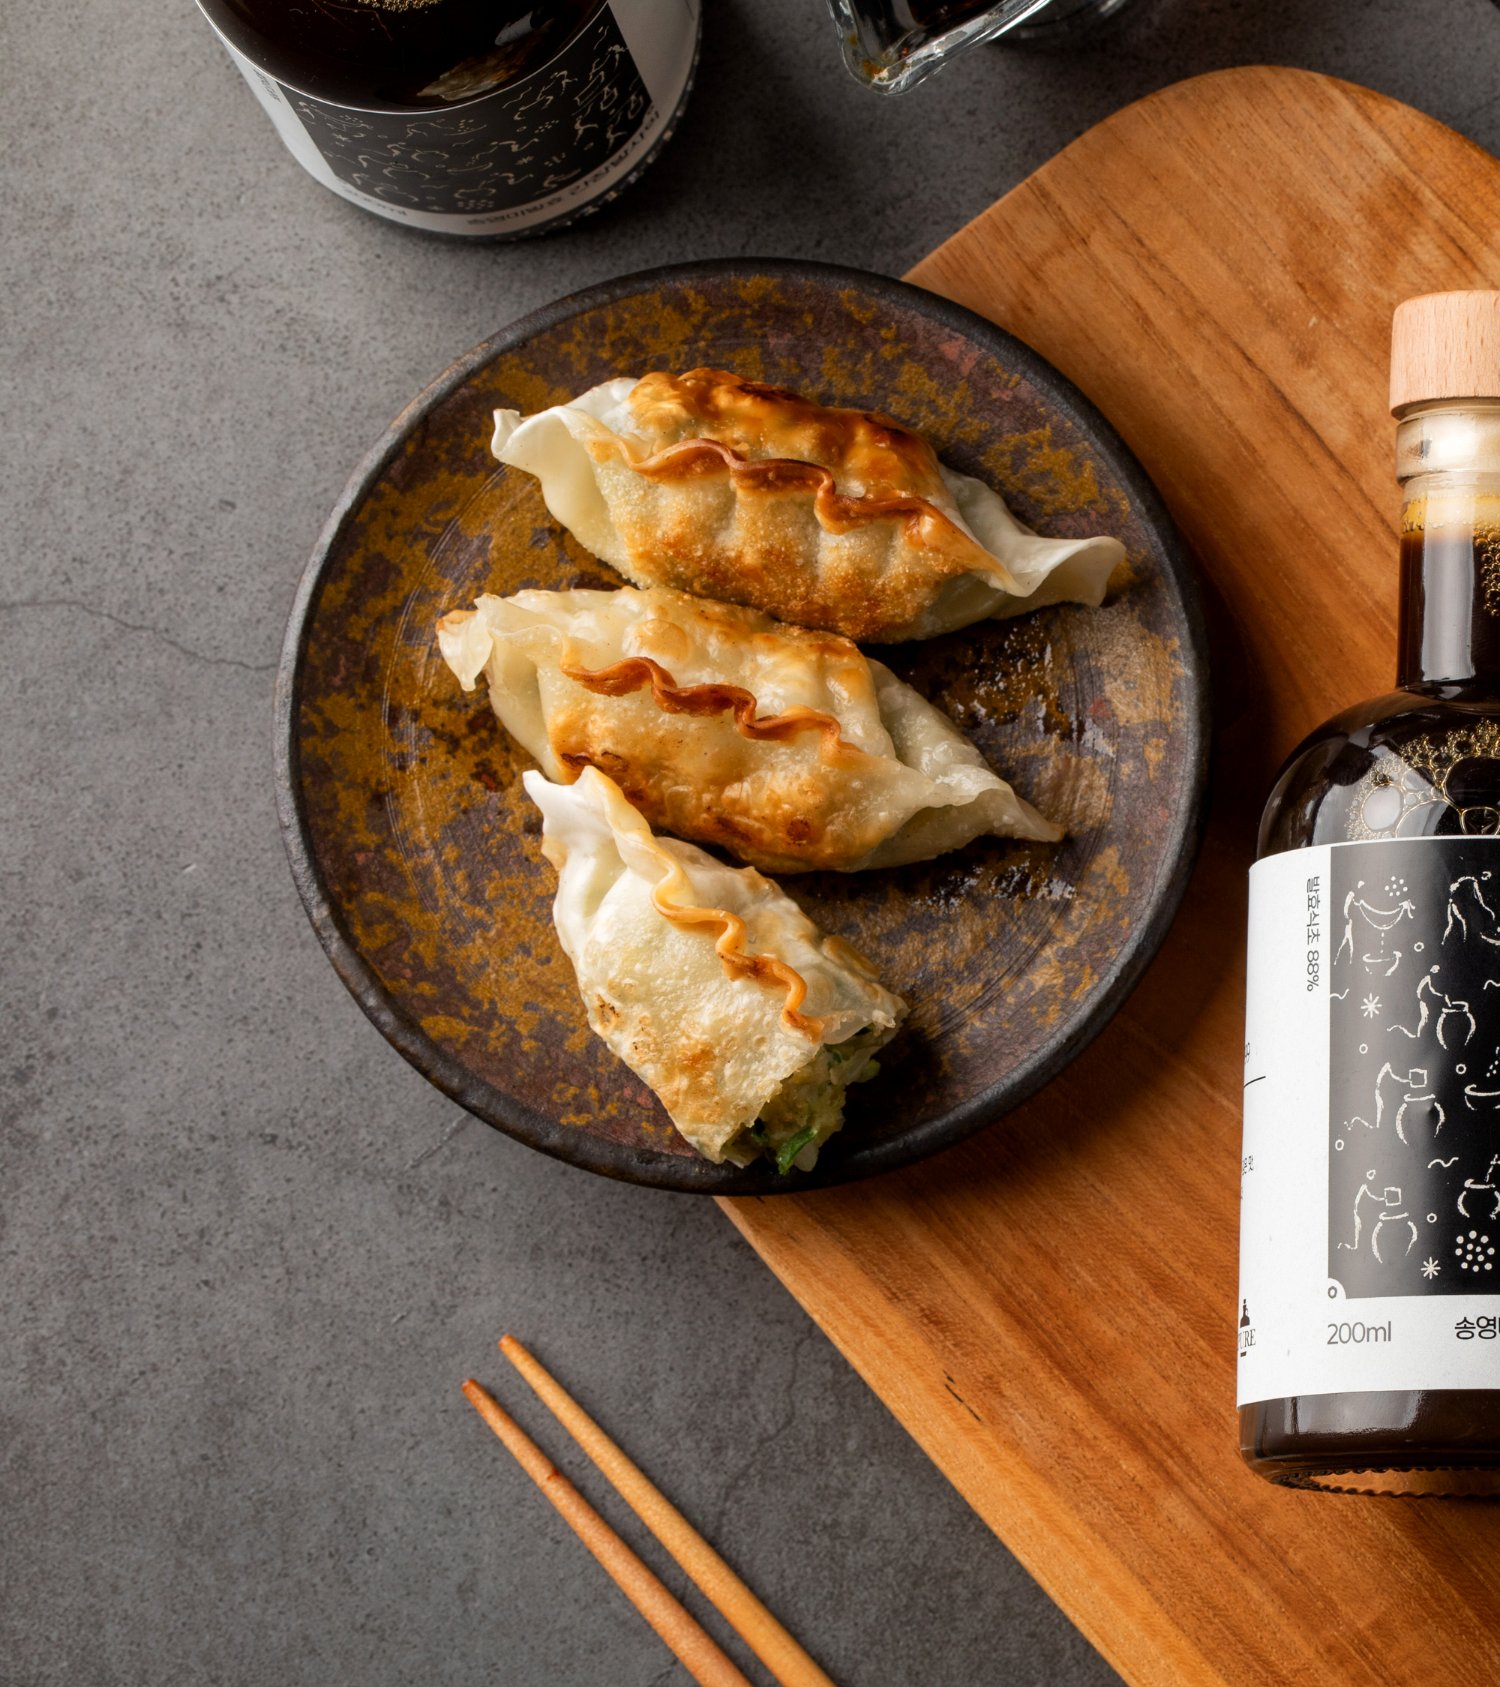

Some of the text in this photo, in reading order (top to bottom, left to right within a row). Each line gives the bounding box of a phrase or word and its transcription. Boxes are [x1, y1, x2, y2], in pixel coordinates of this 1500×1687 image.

[1306, 875, 1321, 992] 발효식초 88%
[1326, 1320, 1392, 1345] 200ml
